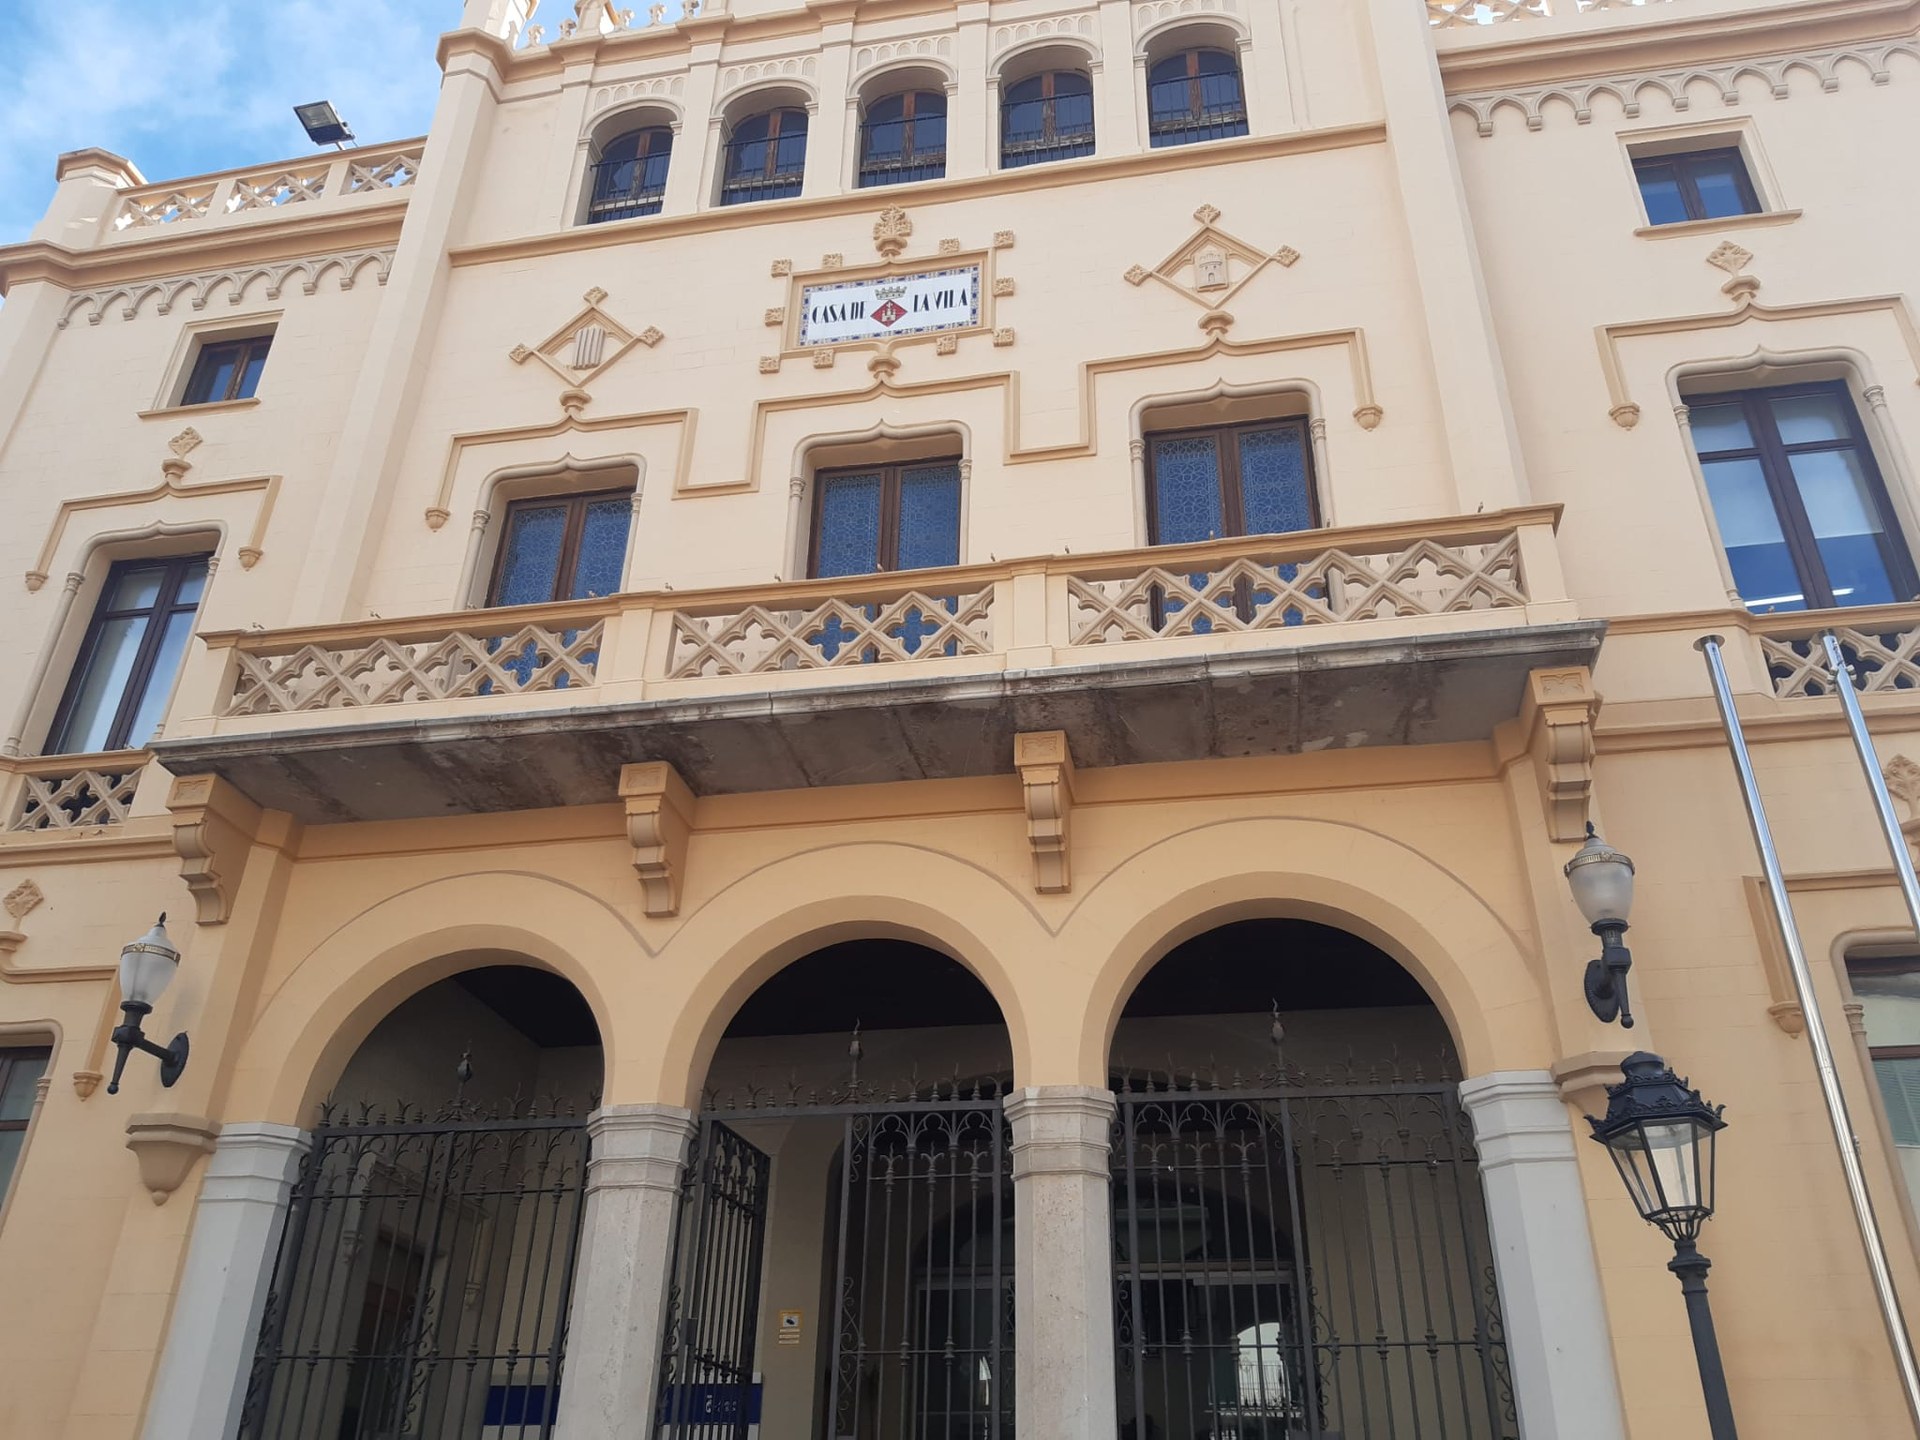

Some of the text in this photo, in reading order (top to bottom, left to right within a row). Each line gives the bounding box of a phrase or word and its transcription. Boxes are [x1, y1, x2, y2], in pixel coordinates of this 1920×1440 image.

[812, 288, 969, 325] CASA DE LA VILA
